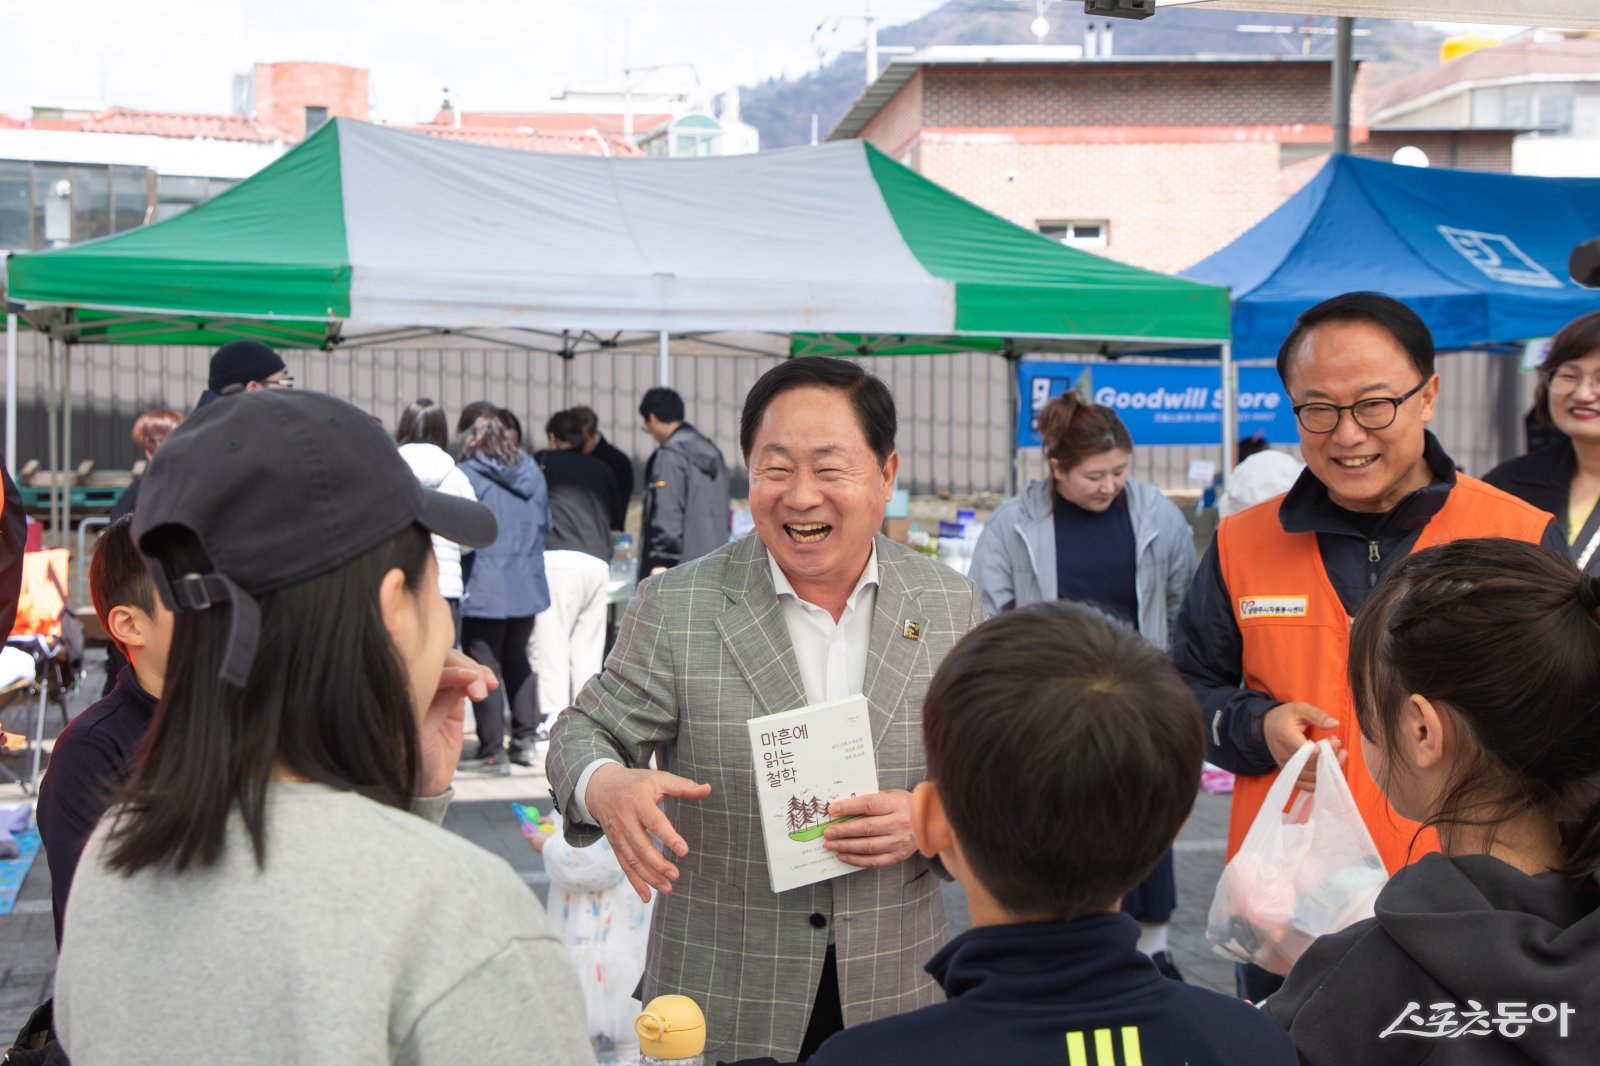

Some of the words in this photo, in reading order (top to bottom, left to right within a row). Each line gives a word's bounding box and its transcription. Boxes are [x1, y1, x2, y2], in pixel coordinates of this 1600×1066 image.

[1095, 386, 1208, 410] Goodwill
[1211, 387, 1280, 410] Sore
[760, 723, 809, 747] 마흔에
[763, 749, 795, 769] 읽는
[766, 767, 798, 788] 철학
